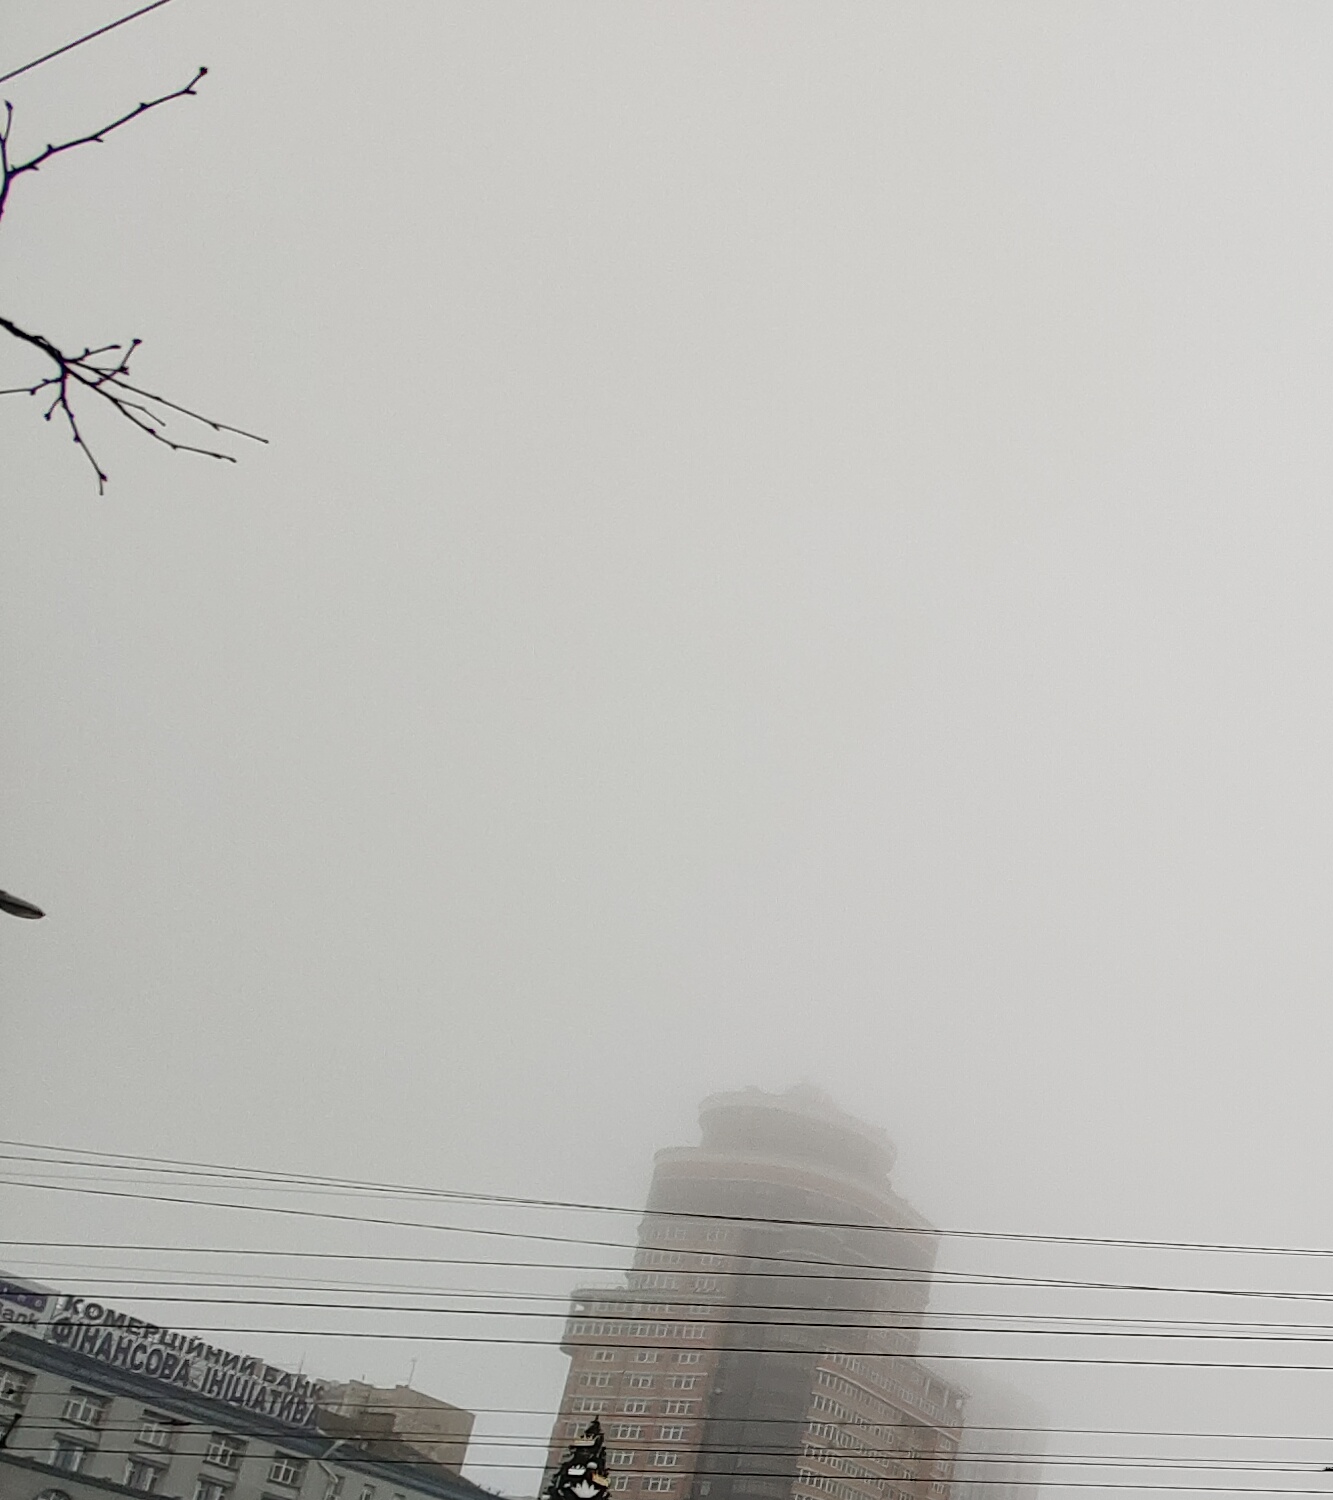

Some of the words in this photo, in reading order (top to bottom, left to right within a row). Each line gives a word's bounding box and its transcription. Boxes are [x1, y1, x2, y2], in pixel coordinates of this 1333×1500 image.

[52, 1317, 191, 1387] ФІНАНСОВА
[200, 1366, 318, 1428] ІНІЦІАТИВА
[61, 1296, 258, 1376] КОМЕРЦІЙНИЙ
[260, 1363, 325, 1401] БАНК
